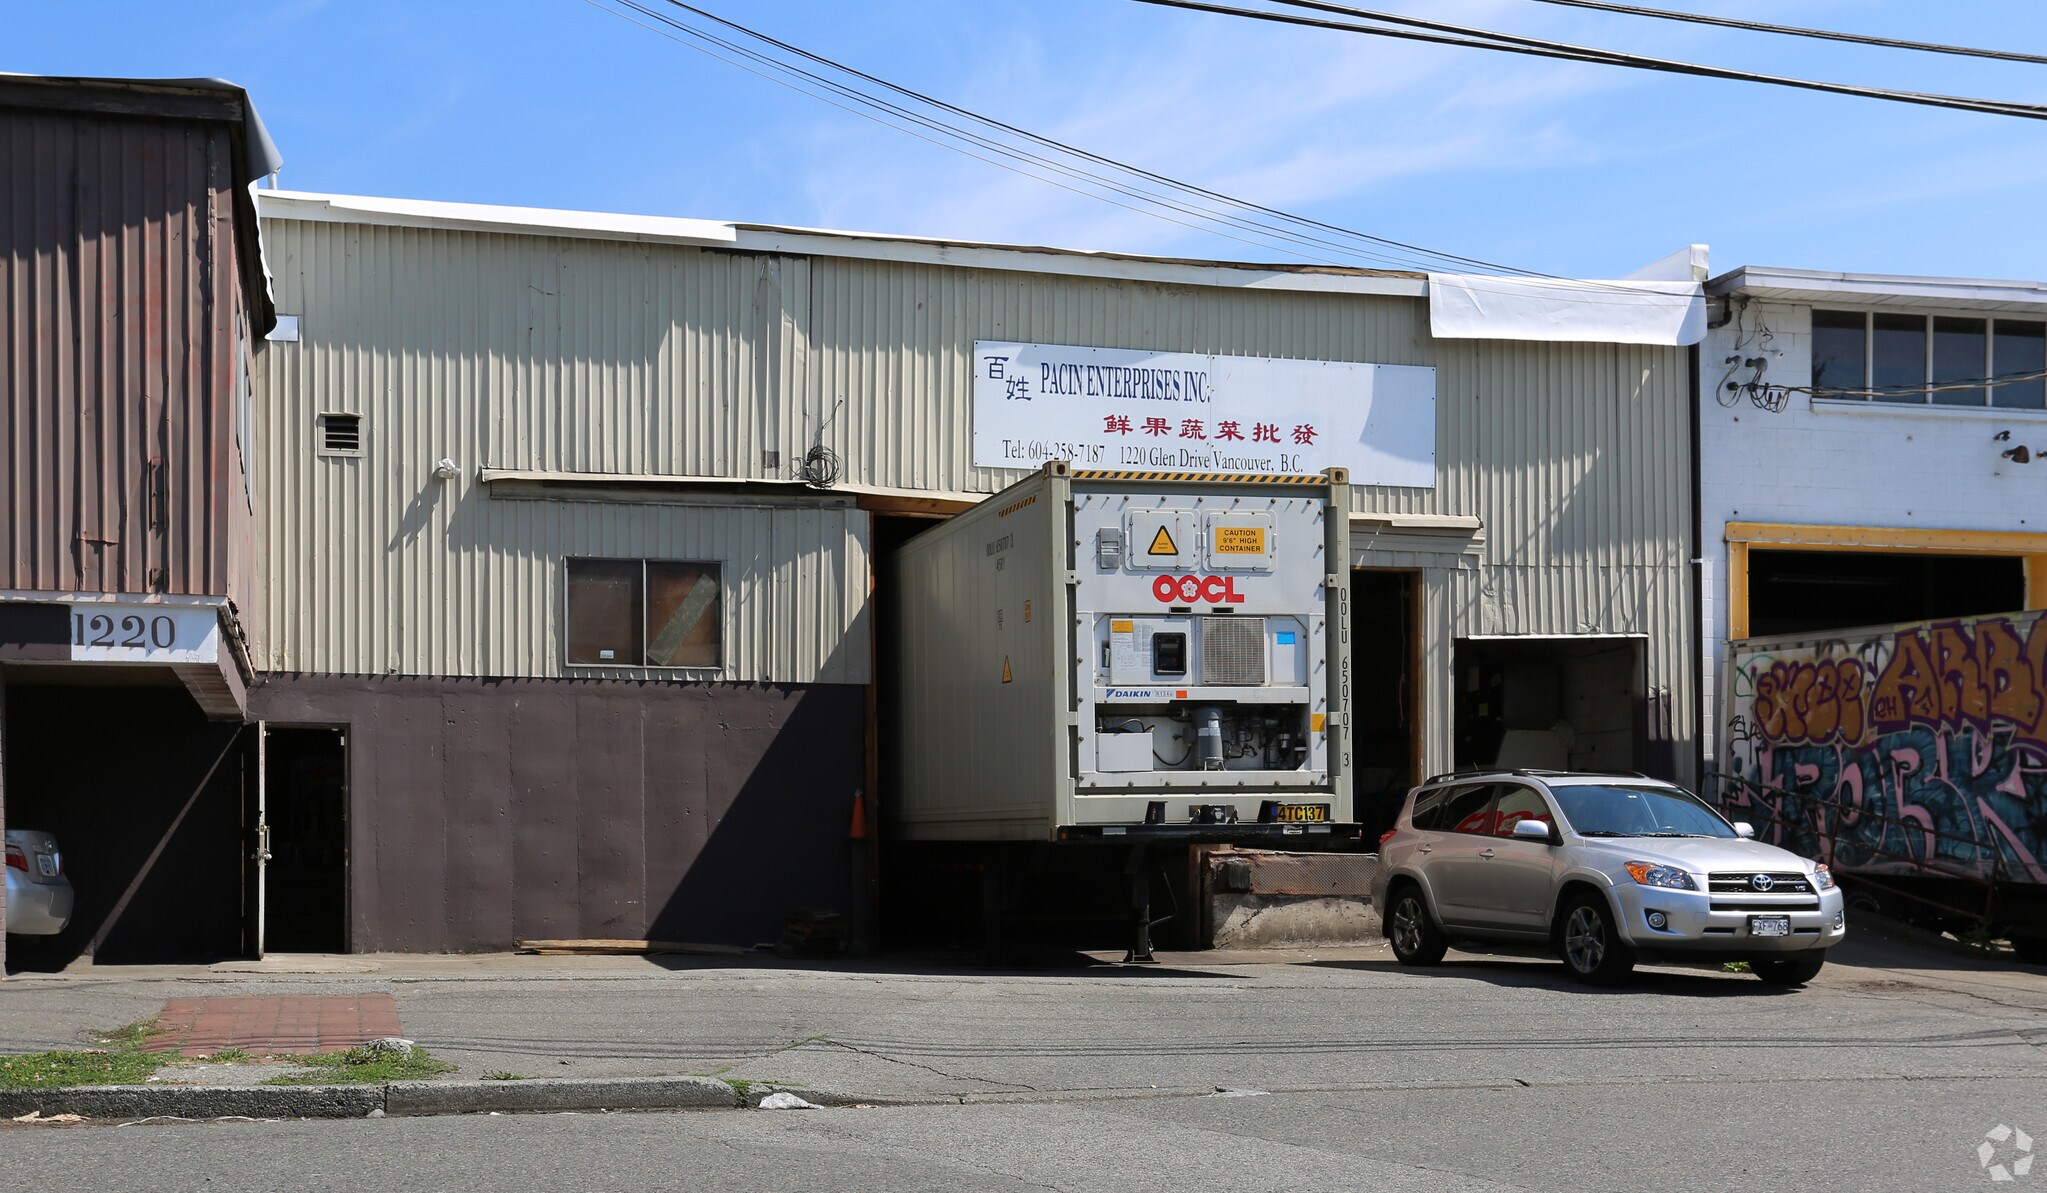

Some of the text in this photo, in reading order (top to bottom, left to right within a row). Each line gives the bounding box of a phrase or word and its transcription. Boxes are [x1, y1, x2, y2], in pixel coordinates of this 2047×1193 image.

[983, 356, 1032, 402] 百姓
[1040, 362, 1210, 404] PACIN ENTERPRISES INC.
[1002, 439, 1304, 473] Tel: 604-258-7187 1220 Glen Drive Vancouver, B.C.
[1152, 574, 1245, 604] OOCL
[73, 613, 176, 649] 1220
[1114, 690, 1151, 698] DAIKIN
[1341, 656, 1350, 740] 650707
[1343, 752, 1350, 768] 3
[1278, 806, 1324, 821] 4TC137
